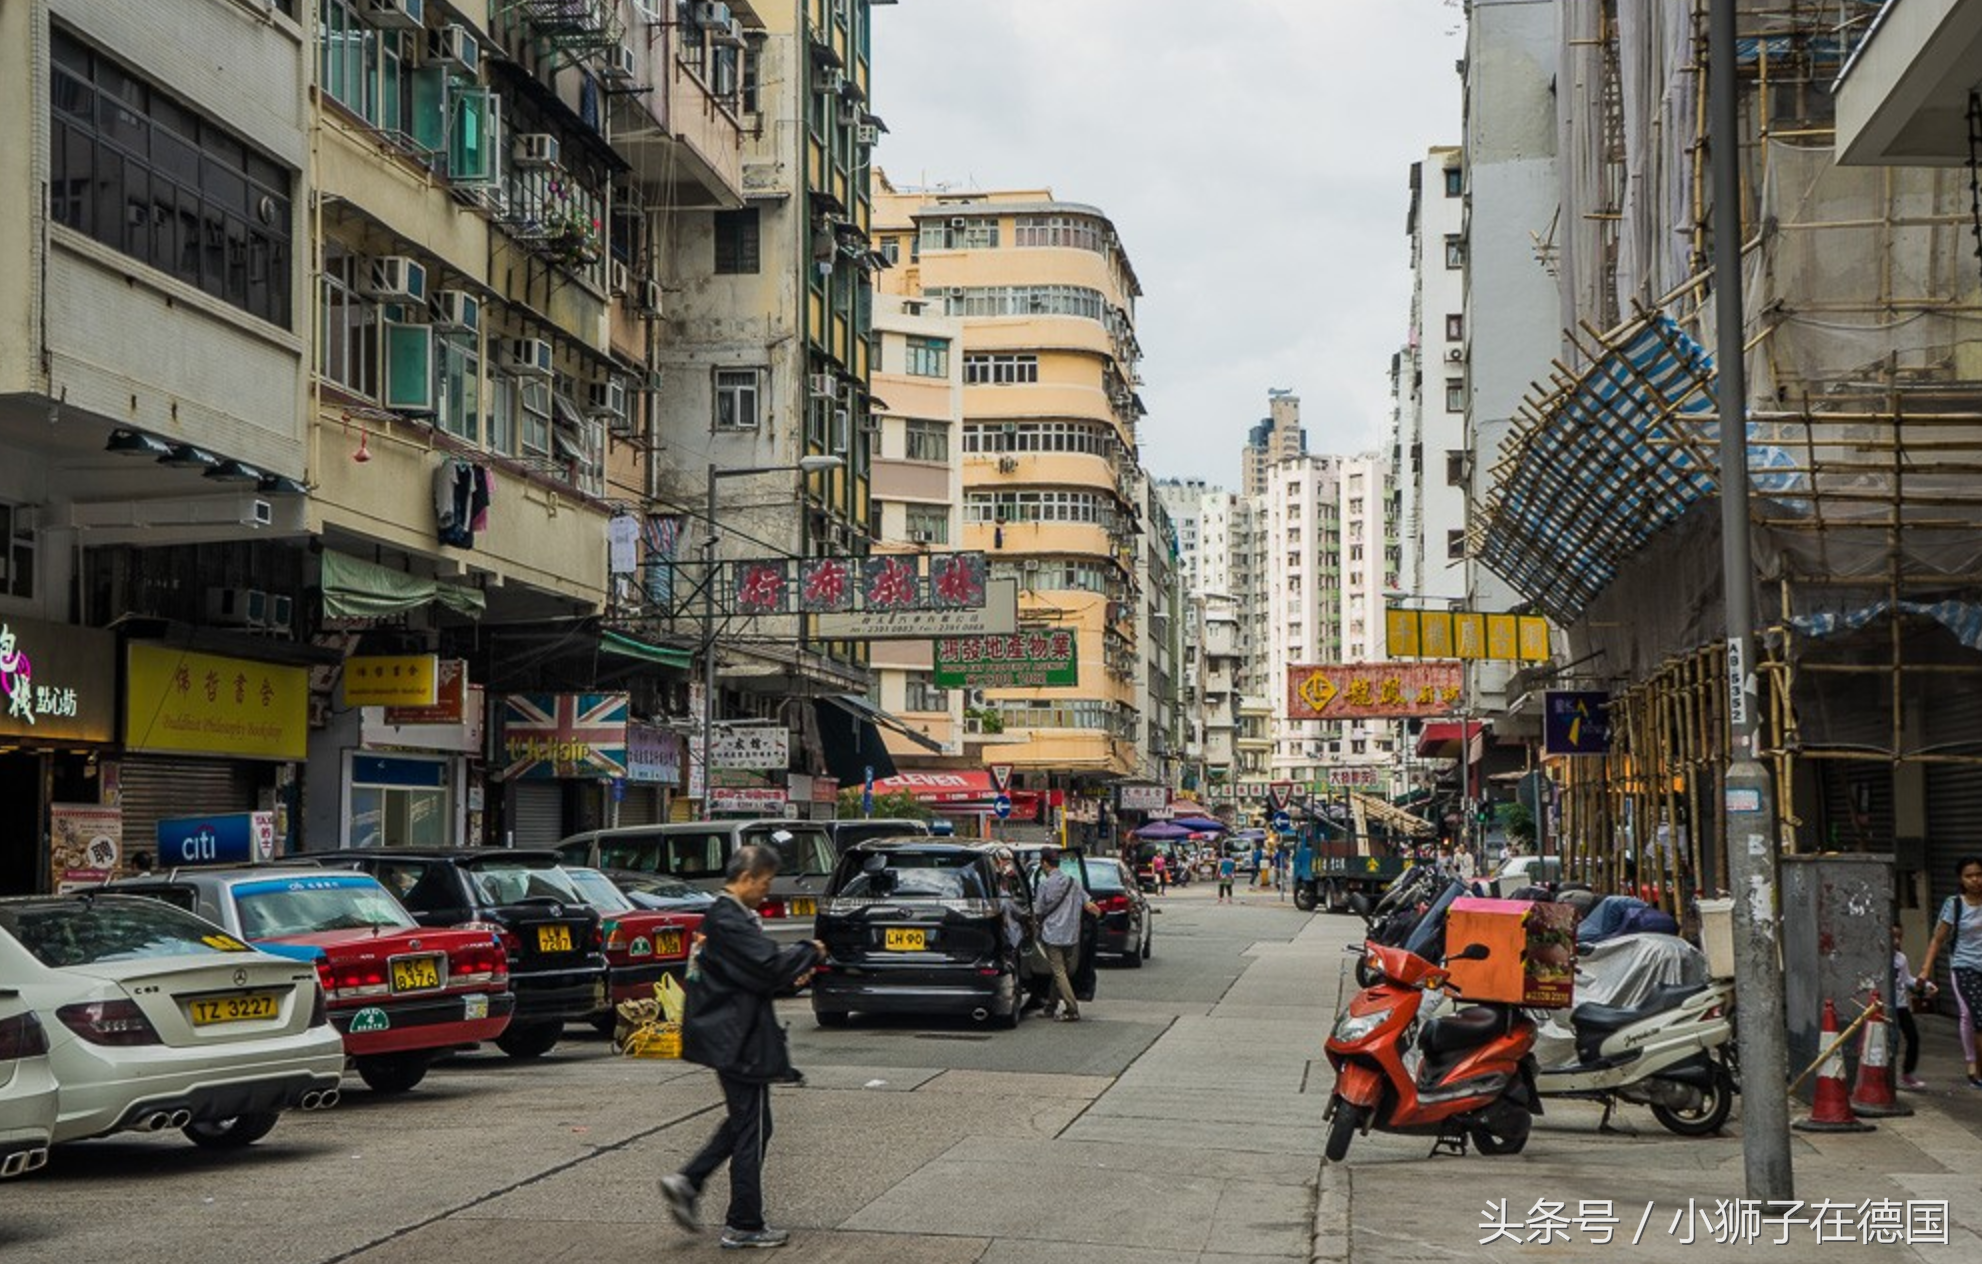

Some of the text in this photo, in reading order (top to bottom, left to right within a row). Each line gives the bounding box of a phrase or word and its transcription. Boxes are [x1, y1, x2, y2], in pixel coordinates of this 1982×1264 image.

[35, 685, 78, 718] 點心坊
[181, 831, 216, 861] citi
[886, 930, 924, 945] LH 90
[196, 998, 272, 1021] TZ 3227
